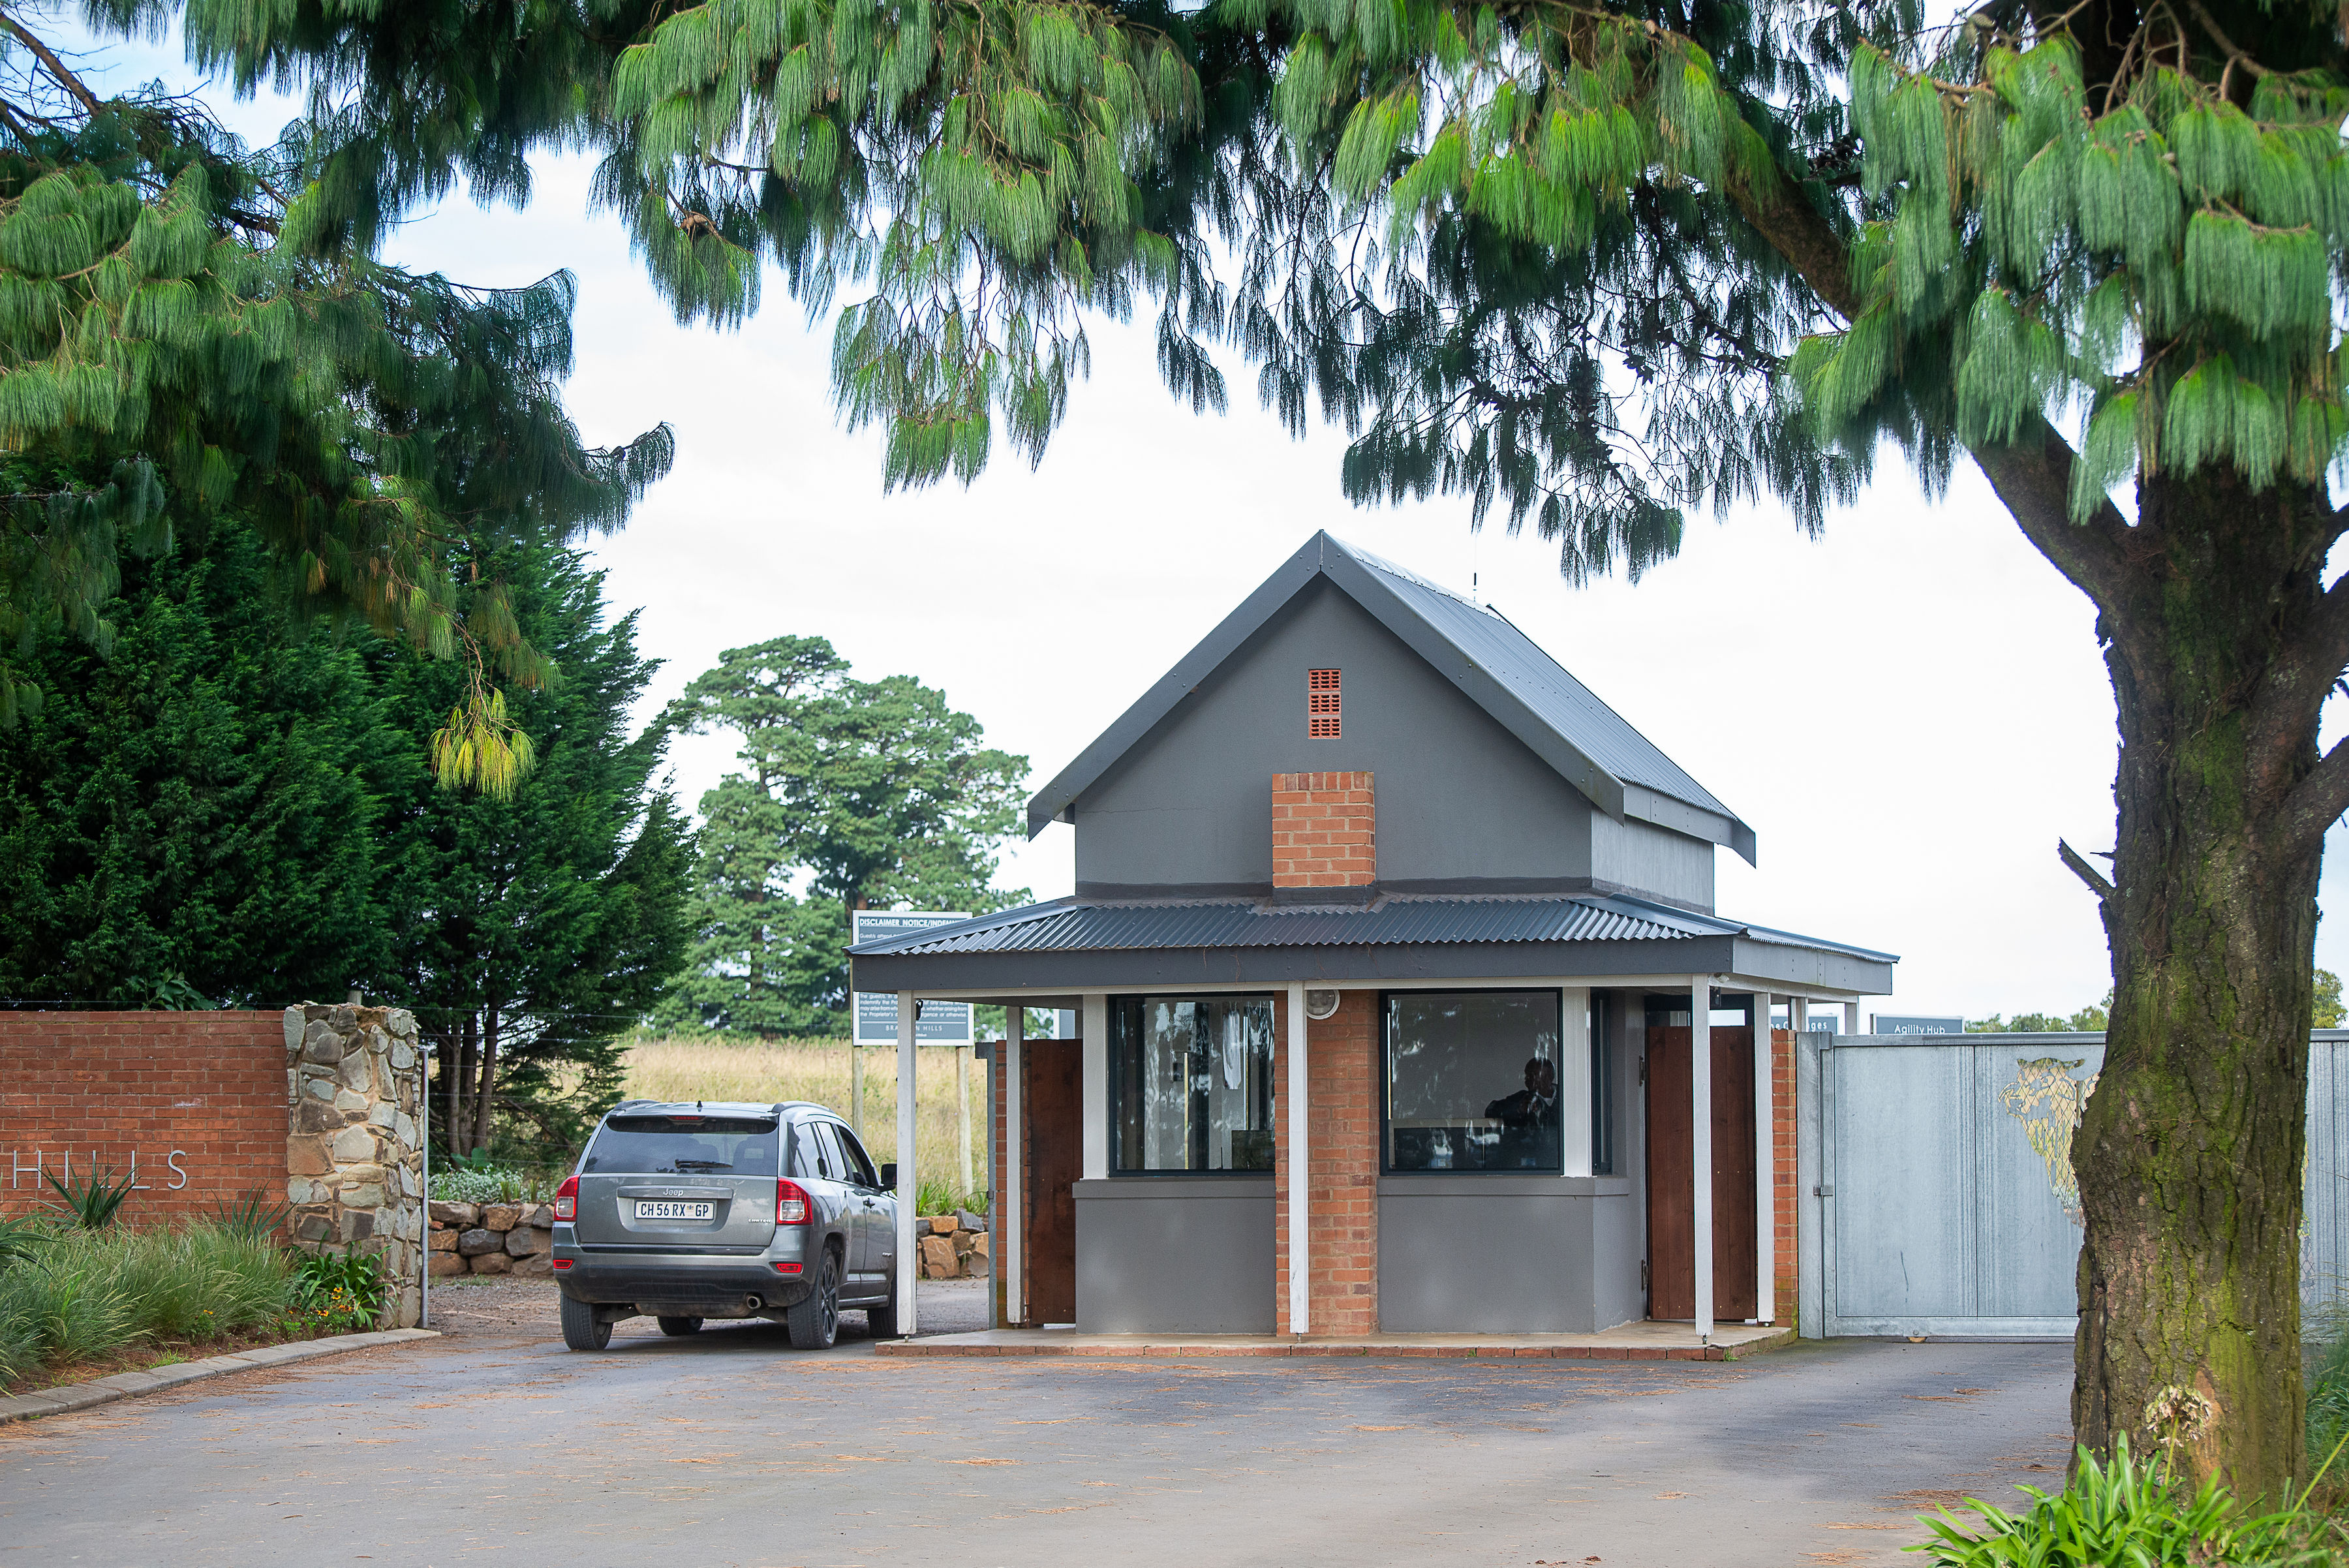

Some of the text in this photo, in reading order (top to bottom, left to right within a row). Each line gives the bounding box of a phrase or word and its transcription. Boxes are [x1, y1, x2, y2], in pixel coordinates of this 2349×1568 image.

[1894, 1024, 1946, 1034] Agility Hub
[13, 1150, 187, 1190] HILLS
[662, 1188, 684, 1197] Jeep
[641, 1203, 709, 1217] CH 56 RX GP
